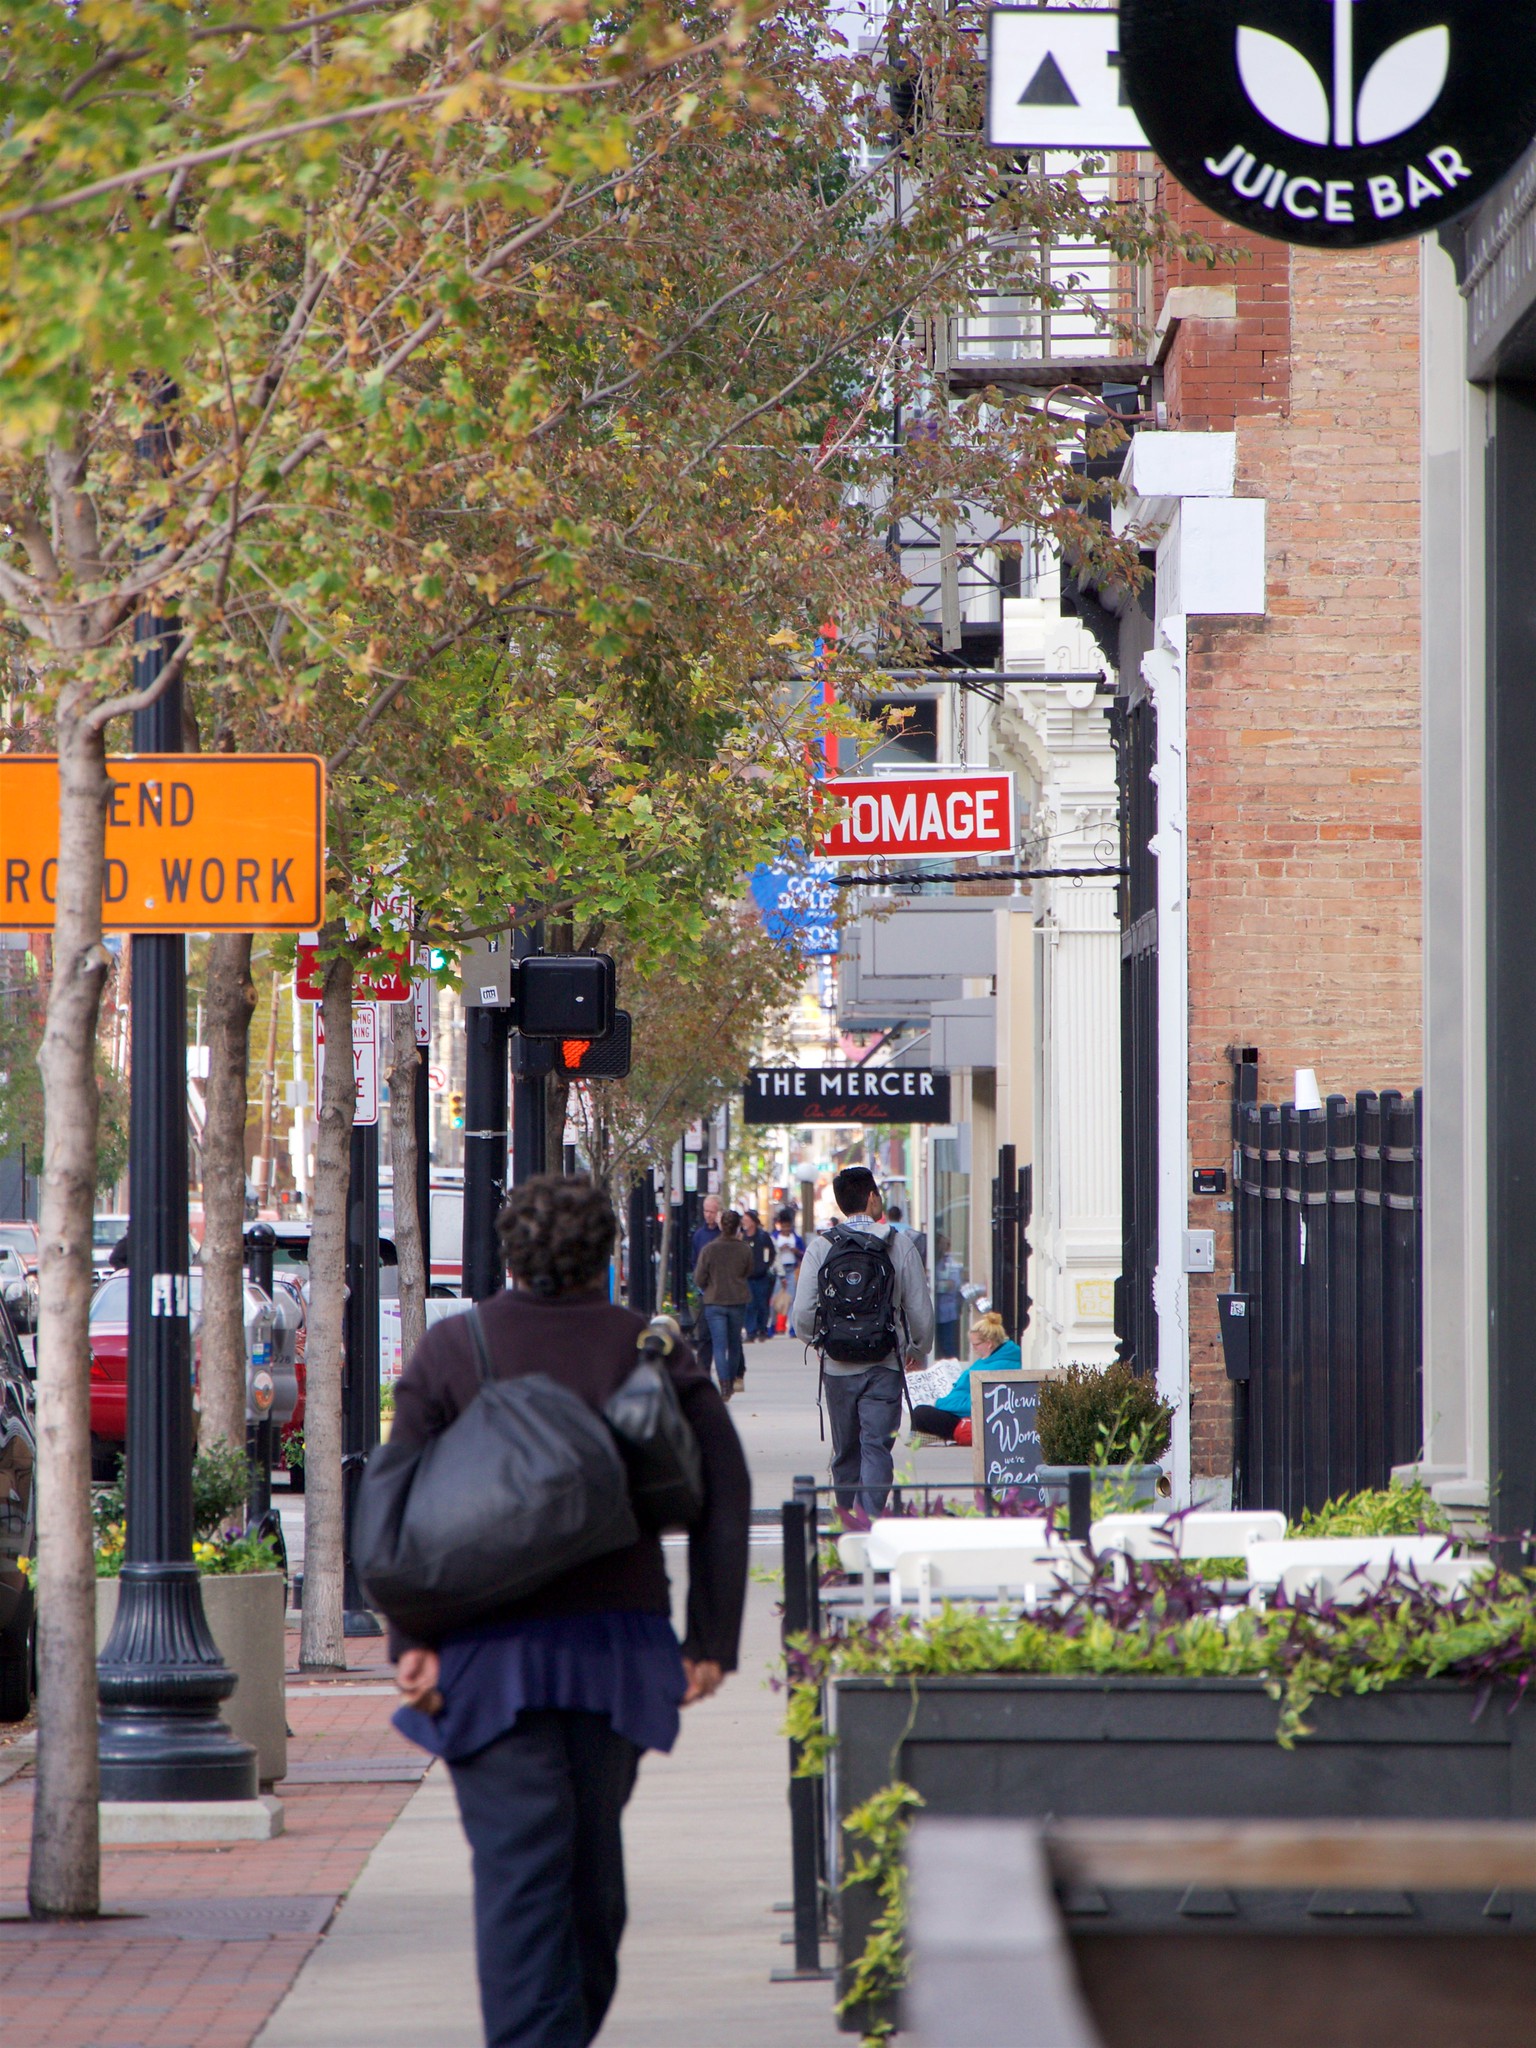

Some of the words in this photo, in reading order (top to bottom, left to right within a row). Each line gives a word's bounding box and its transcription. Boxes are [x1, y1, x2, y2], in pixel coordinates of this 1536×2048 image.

[1204, 143, 1355, 222] JUICE
[1367, 145, 1473, 219] BAR
[107, 782, 195, 827] END
[6, 858, 129, 903] ROD
[161, 858, 296, 904] WORK
[756, 1072, 807, 1097] THE
[820, 1071, 935, 1097] MERCER
[906, 1366, 944, 1386] EGNANT
[908, 1377, 948, 1396] OMELESS
[1004, 1455, 1026, 1465] we're
[987, 1460, 1040, 1500] Open
